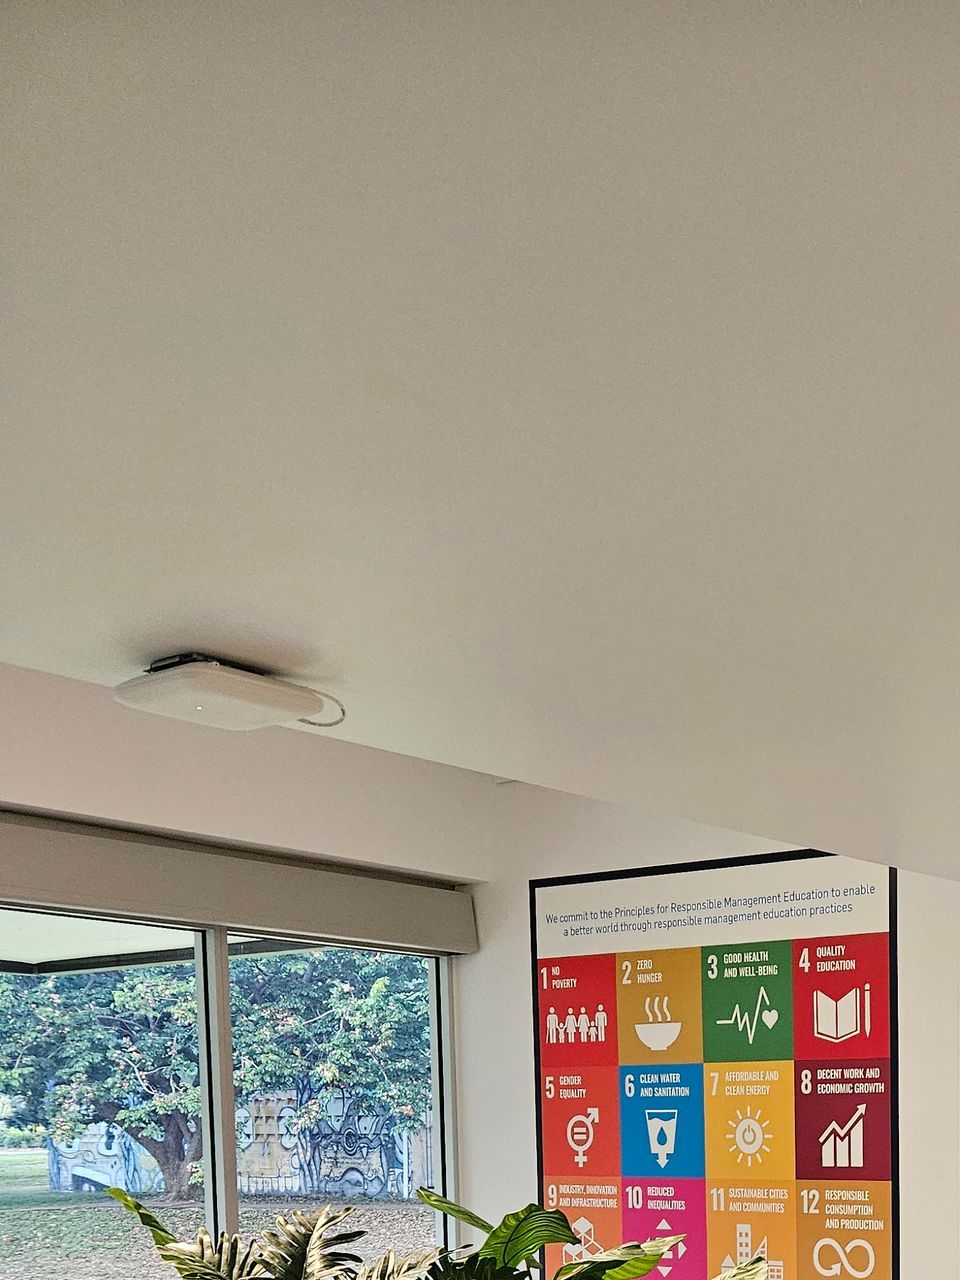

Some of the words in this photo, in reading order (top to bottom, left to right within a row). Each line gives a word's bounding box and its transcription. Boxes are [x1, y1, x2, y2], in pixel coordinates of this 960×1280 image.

[545, 914, 558, 924] We
[560, 910, 589, 923] commit
[590, 911, 598, 920] to
[600, 909, 612, 919] the
[614, 904, 655, 918] Principles
[656, 903, 669, 914] for
[670, 899, 722, 914] Responsible
[724, 893, 781, 909] Management
[783, 888, 829, 903] Education
[831, 888, 841, 897] to
[843, 884, 876, 896] enable
[563, 927, 569, 937] a
[570, 923, 593, 936] better
[595, 921, 619, 934] world
[620, 919, 652, 933] through
[654, 915, 702, 931] responsible
[704, 910, 761, 926] management
[763, 906, 807, 920] education
[809, 903, 853, 917] practices
[724, 953, 742, 964] GOOD
[744, 951, 768, 962] HEALTH
[816, 945, 846, 958] QUALITY
[637, 959, 653, 970] ZERO
[799, 947, 811, 973] 4
[816, 959, 856, 972] EDUCATION
[552, 966, 560, 976] NO
[707, 954, 718, 979] 3
[724, 967, 738, 978] AND
[739, 965, 778, 977] WELL-BEING
[540, 967, 548, 990] 1
[621, 961, 632, 985] 2
[637, 972, 663, 984] HUNGER
[552, 978, 577, 989] POVERTY
[559, 1075, 582, 1085] GENDER
[640, 1074, 659, 1084] CLEAN
[660, 1073, 681, 1083] WATER
[725, 1071, 764, 1082] AFFORDABLE
[765, 1070, 779, 1081] AND
[817, 1069, 842, 1080] DECENT
[843, 1068, 864, 1079] WORK
[865, 1068, 880, 1079] AND
[545, 1076, 554, 1099] 5
[625, 1074, 635, 1098] 6
[710, 1072, 719, 1096] 7
[800, 1069, 812, 1095] 8
[818, 1083, 853, 1094] ECONOMIC
[854, 1082, 885, 1093] GROWTH
[559, 1088, 587, 1099] EQUALITY
[640, 1087, 653, 1097] AND
[654, 1086, 690, 1097] SANITATION
[725, 1086, 746, 1096] CLEAN
[746, 1085, 771, 1095] ENERGY
[548, 1184, 557, 1207] 9
[559, 1184, 585, 1195] INDUSTRY,
[586, 1185, 617, 1195] INNOVATION
[647, 1186, 675, 1197] REDUCED
[729, 1188, 769, 1199] SUSTAINABLE
[769, 1188, 788, 1199] CITIES
[825, 1190, 870, 1201] RESPONSIBLE
[559, 1198, 571, 1207] AND
[572, 1198, 618, 1208] INFRASTRUCTURE
[625, 1186, 643, 1209] 10
[710, 1188, 725, 1211] 11
[800, 1189, 820, 1214] 12
[647, 1200, 686, 1211] INEQUALITIES
[729, 1202, 742, 1212] AND
[743, 1202, 785, 1214] COMMUNITIES
[825, 1204, 873, 1216] CONSUMPTION
[825, 1219, 839, 1229] AND
[840, 1219, 884, 1231] PRODUCTION
